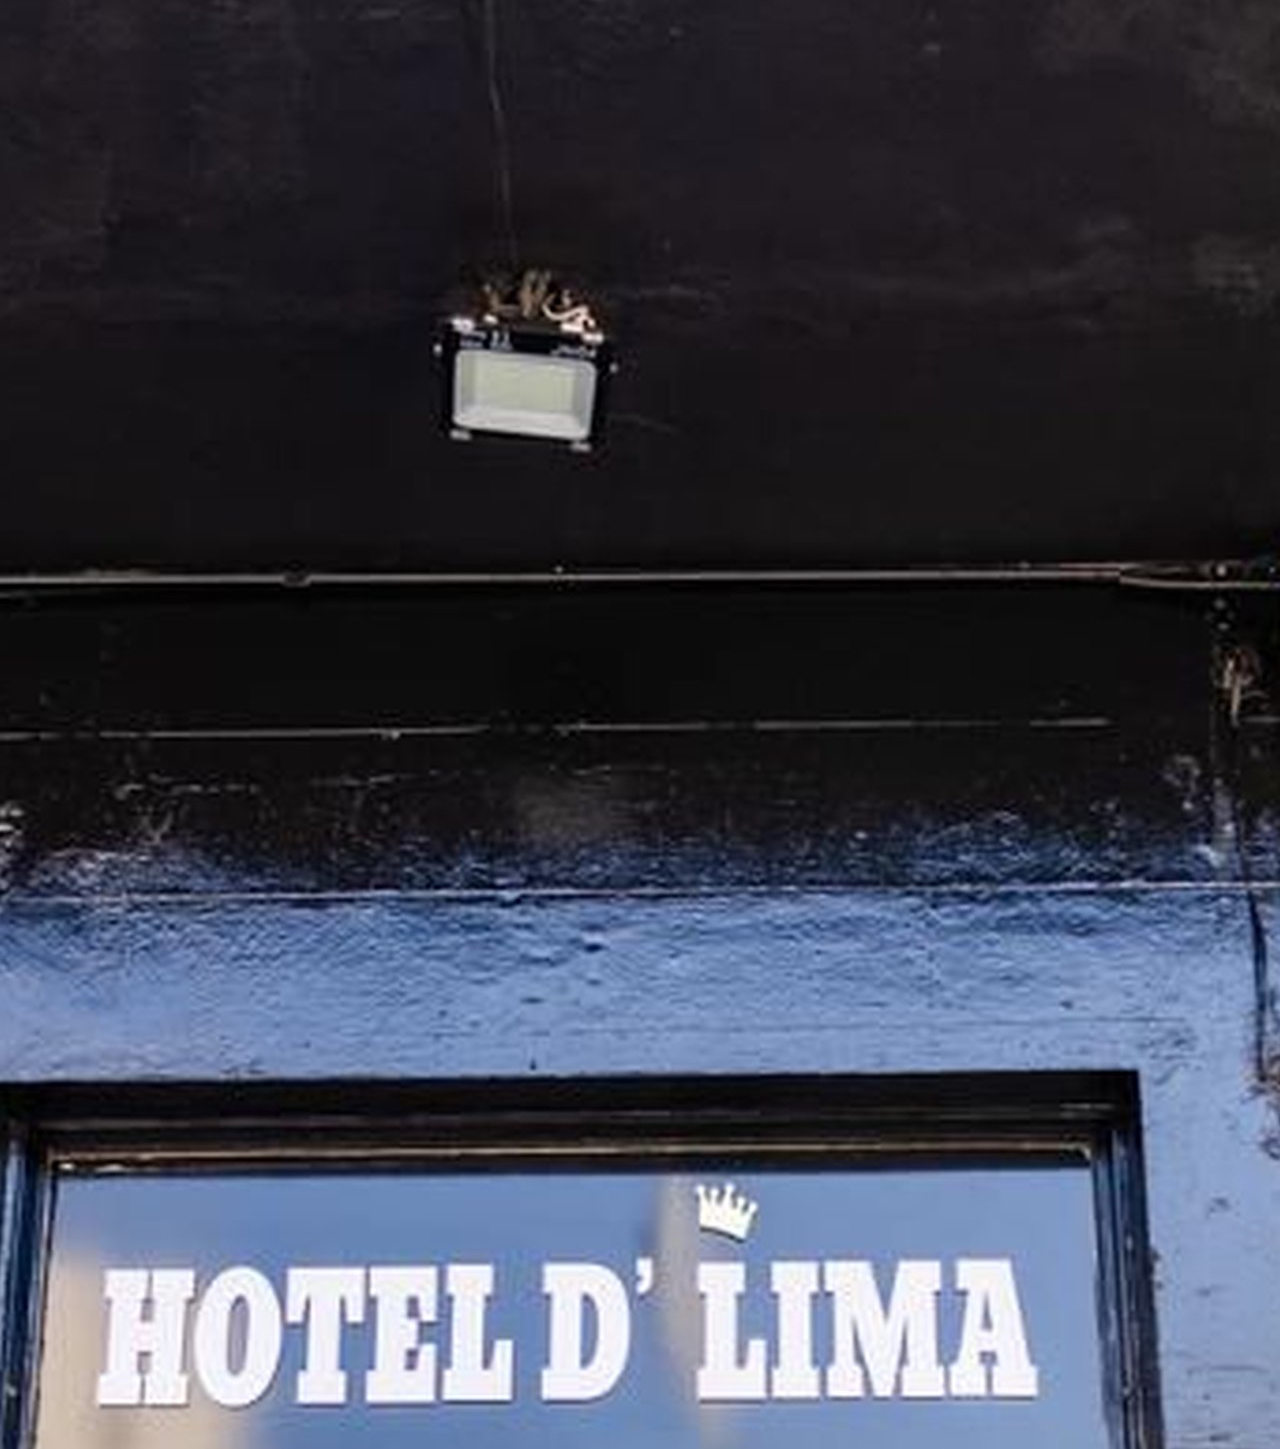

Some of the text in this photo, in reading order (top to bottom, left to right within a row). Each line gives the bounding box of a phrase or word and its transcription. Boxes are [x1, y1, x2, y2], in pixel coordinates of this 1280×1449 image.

[97, 1258, 1038, 1406] HOTEL D' LIMA
